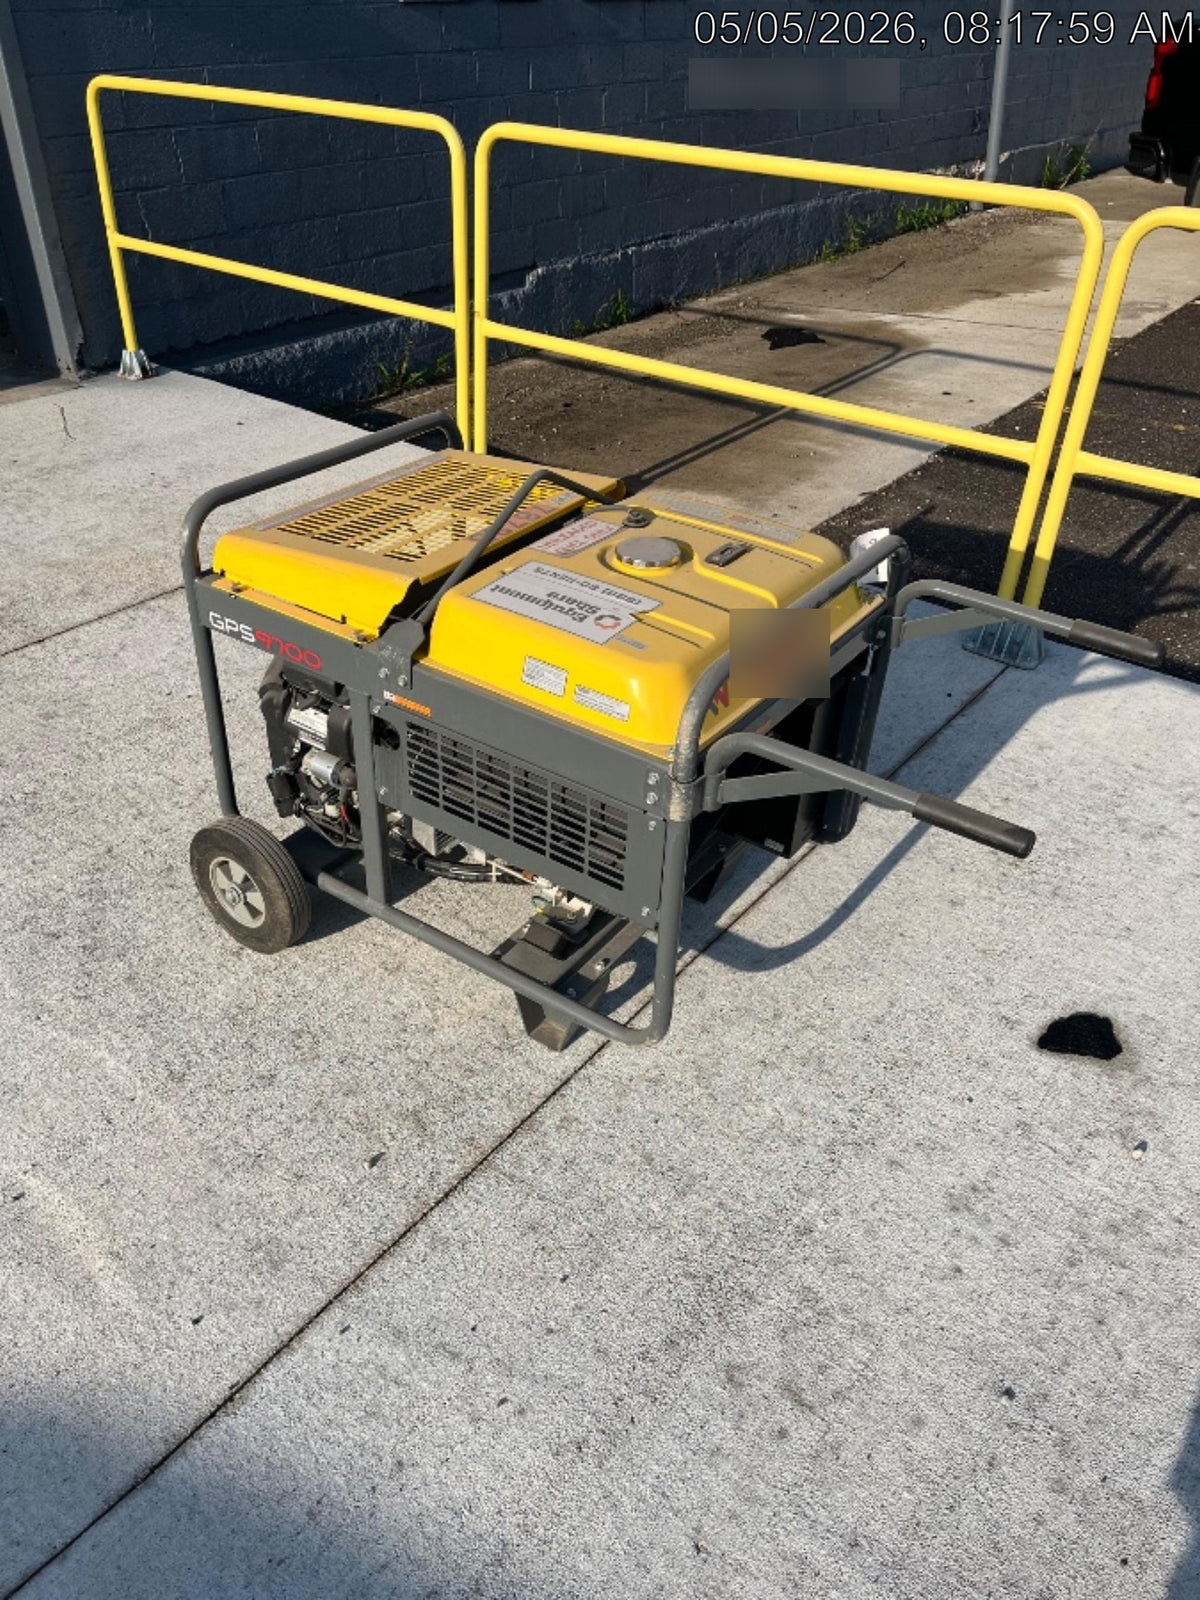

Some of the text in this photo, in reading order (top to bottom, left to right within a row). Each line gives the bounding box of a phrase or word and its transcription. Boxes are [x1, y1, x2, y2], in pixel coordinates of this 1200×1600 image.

[489, 584, 590, 623] Equipment
[545, 590, 601, 615] Share
[208, 611, 322, 670] GPS9700
